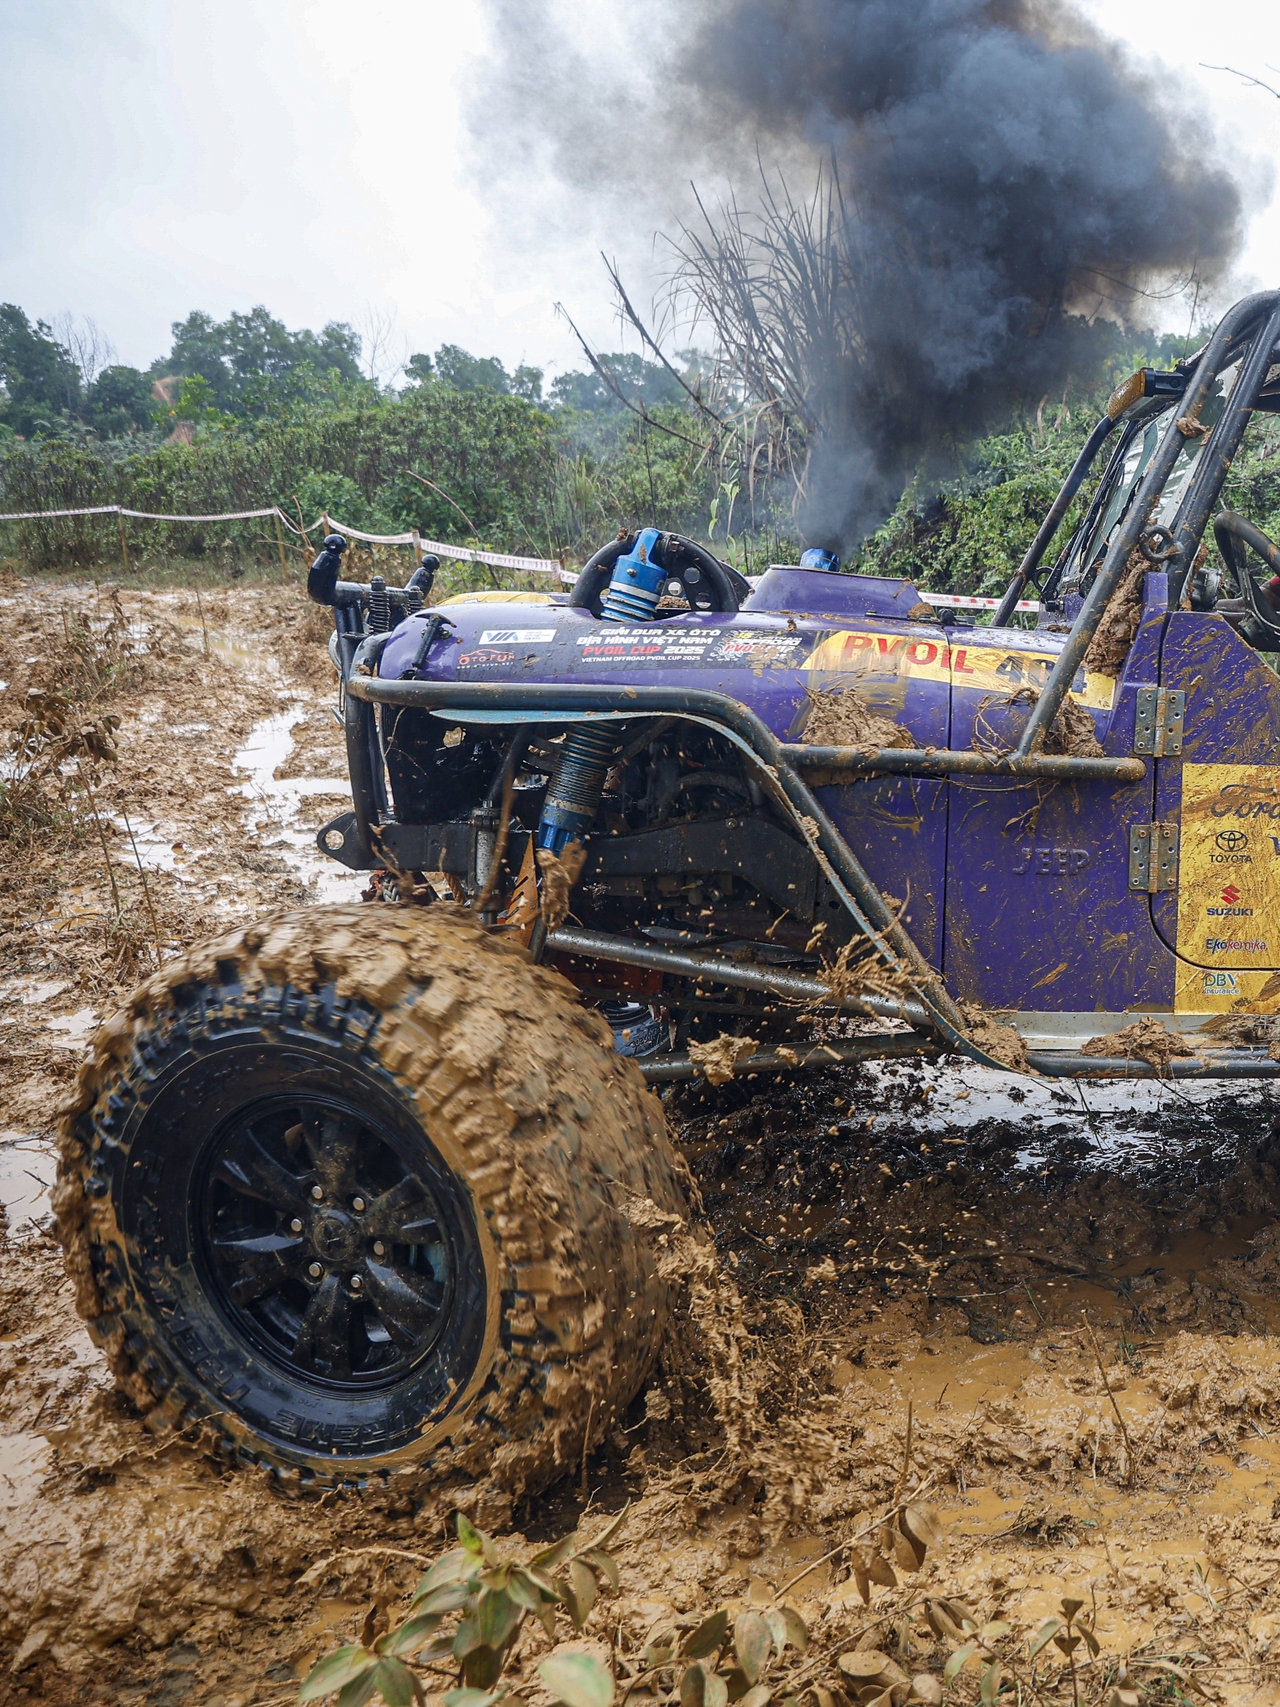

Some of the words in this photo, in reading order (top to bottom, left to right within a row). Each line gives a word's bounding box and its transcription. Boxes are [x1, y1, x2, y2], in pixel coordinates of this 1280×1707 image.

[604, 635, 639, 645] HÌNH
[642, 636, 677, 646] VIỆT
[679, 637, 714, 645] NAM
[582, 645, 627, 656] PVOIL
[630, 645, 662, 655] CUP
[663, 645, 706, 655] 2025
[842, 635, 974, 674] PVOIL
[1012, 847, 1090, 876] JEEP
[1209, 854, 1252, 864] TOYOTA
[1207, 907, 1253, 916] SUZUKI
[270, 1377, 449, 1447] EXTREME
